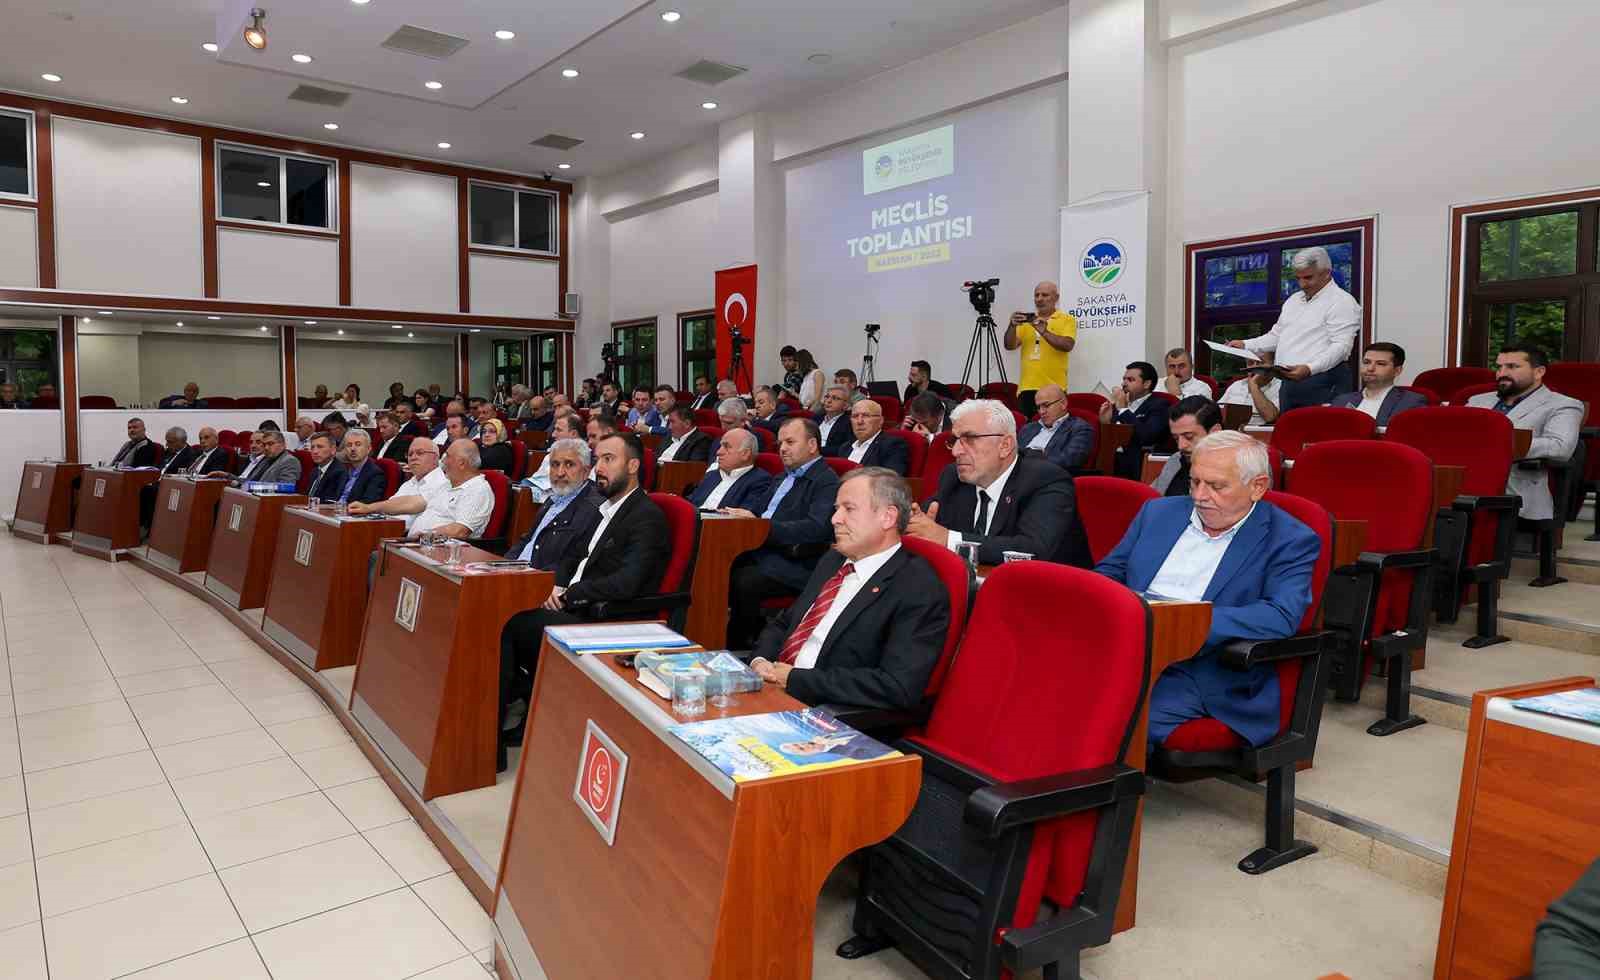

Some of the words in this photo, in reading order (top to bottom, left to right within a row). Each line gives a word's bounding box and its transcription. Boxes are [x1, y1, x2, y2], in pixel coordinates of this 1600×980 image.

[871, 193, 949, 230] MECLİS
[847, 215, 972, 257] TOPLANTISI
[1077, 293, 1127, 306] SAKARYA
[1075, 316, 1133, 329] ELEDİYESİ
